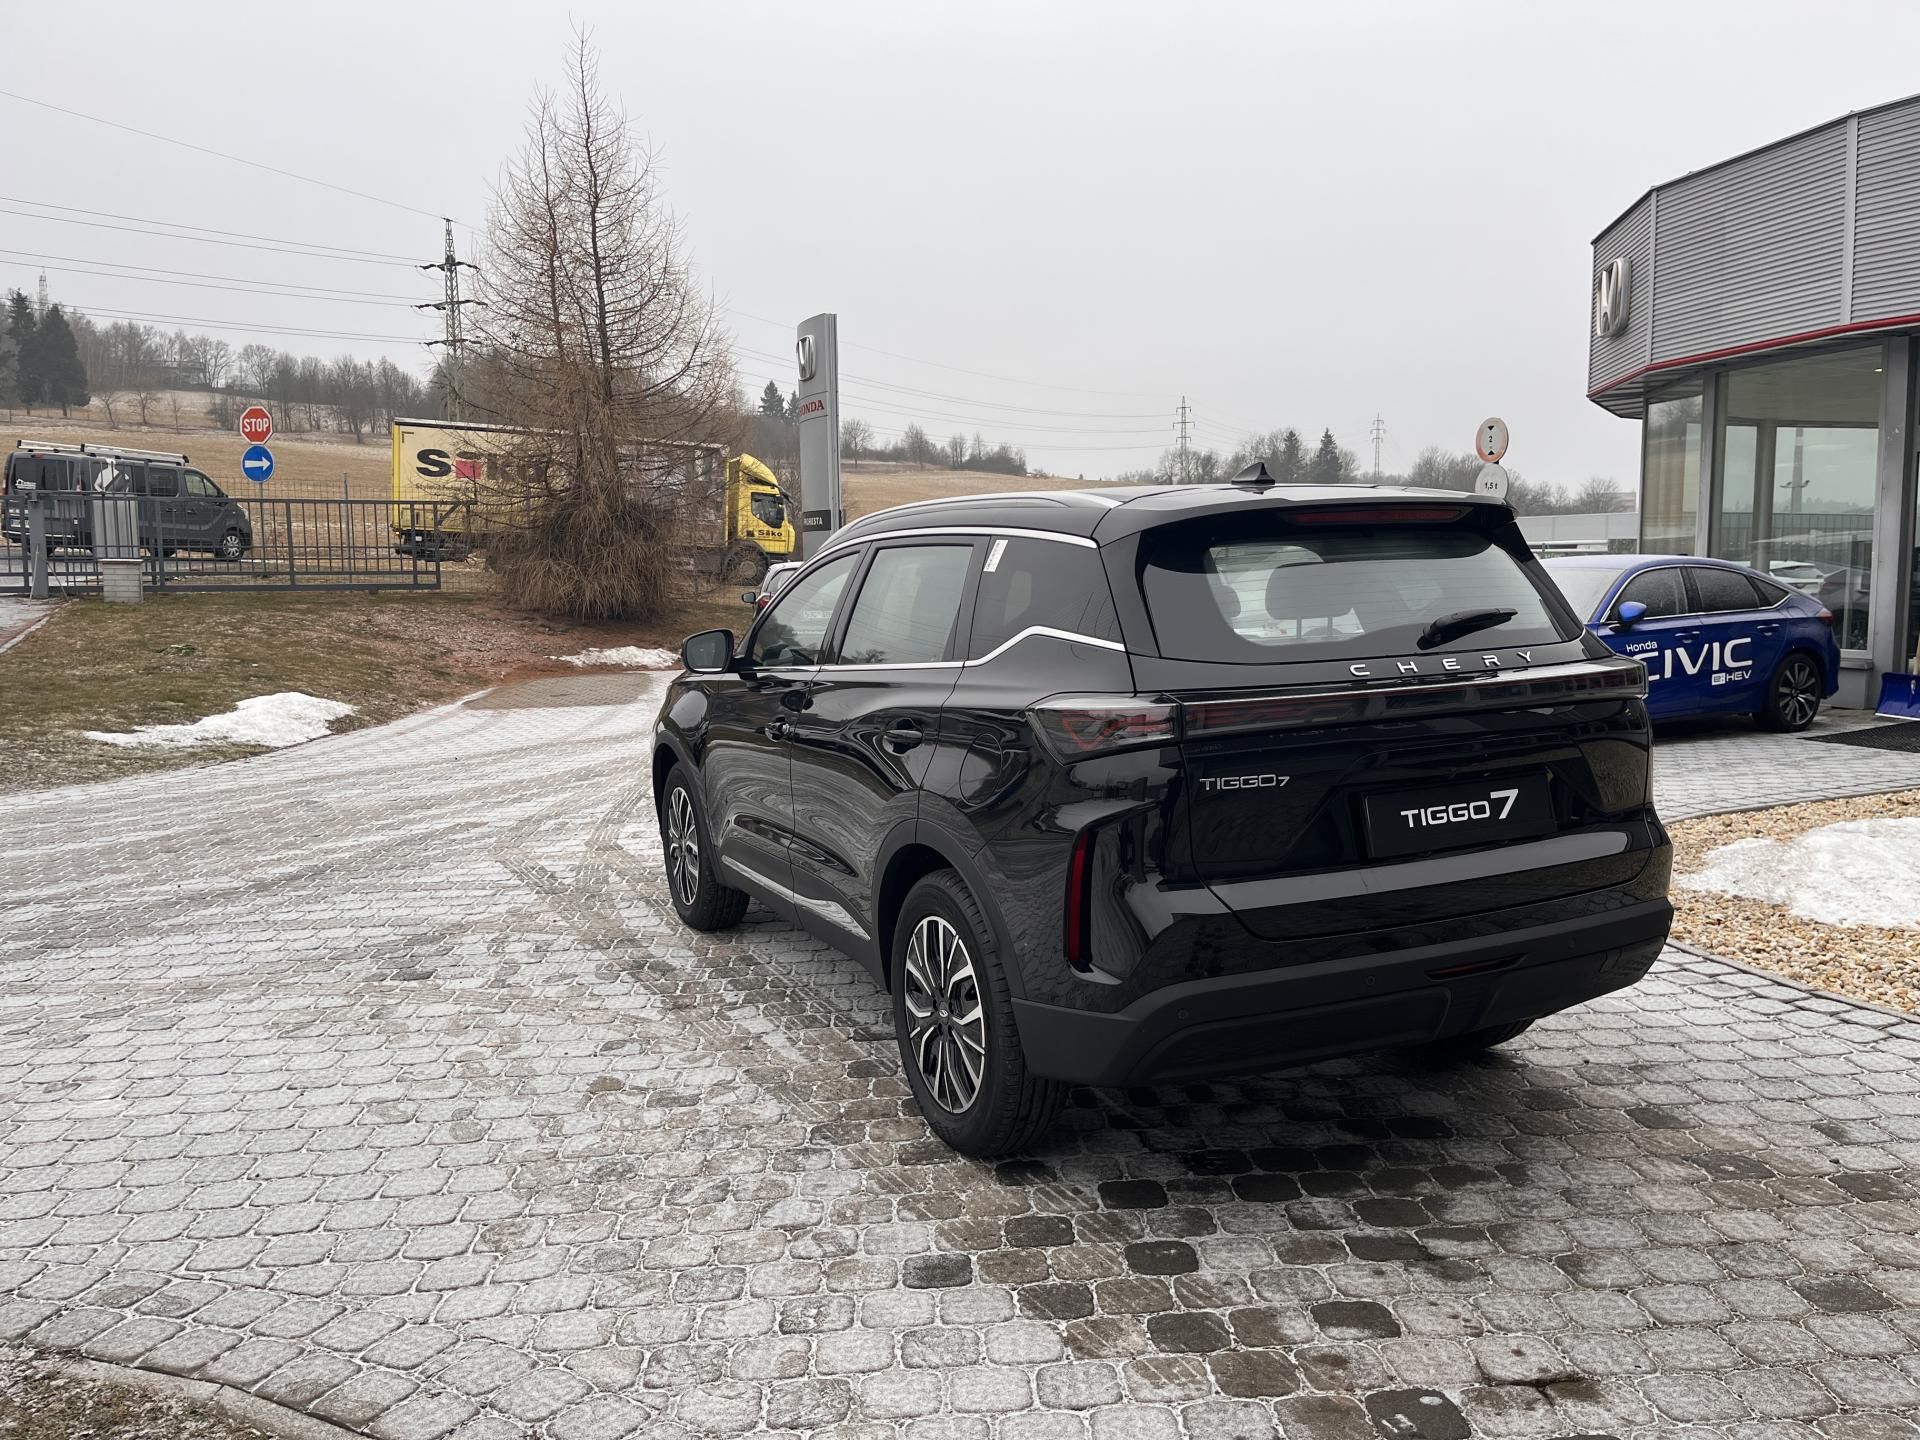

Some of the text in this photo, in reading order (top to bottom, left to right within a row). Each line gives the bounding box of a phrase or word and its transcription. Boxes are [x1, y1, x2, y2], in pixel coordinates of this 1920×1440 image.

[800, 399, 825, 416] ONDA
[243, 418, 269, 432] STOP
[1626, 641, 1658, 653] Honda
[1349, 650, 1534, 677] CHERY
